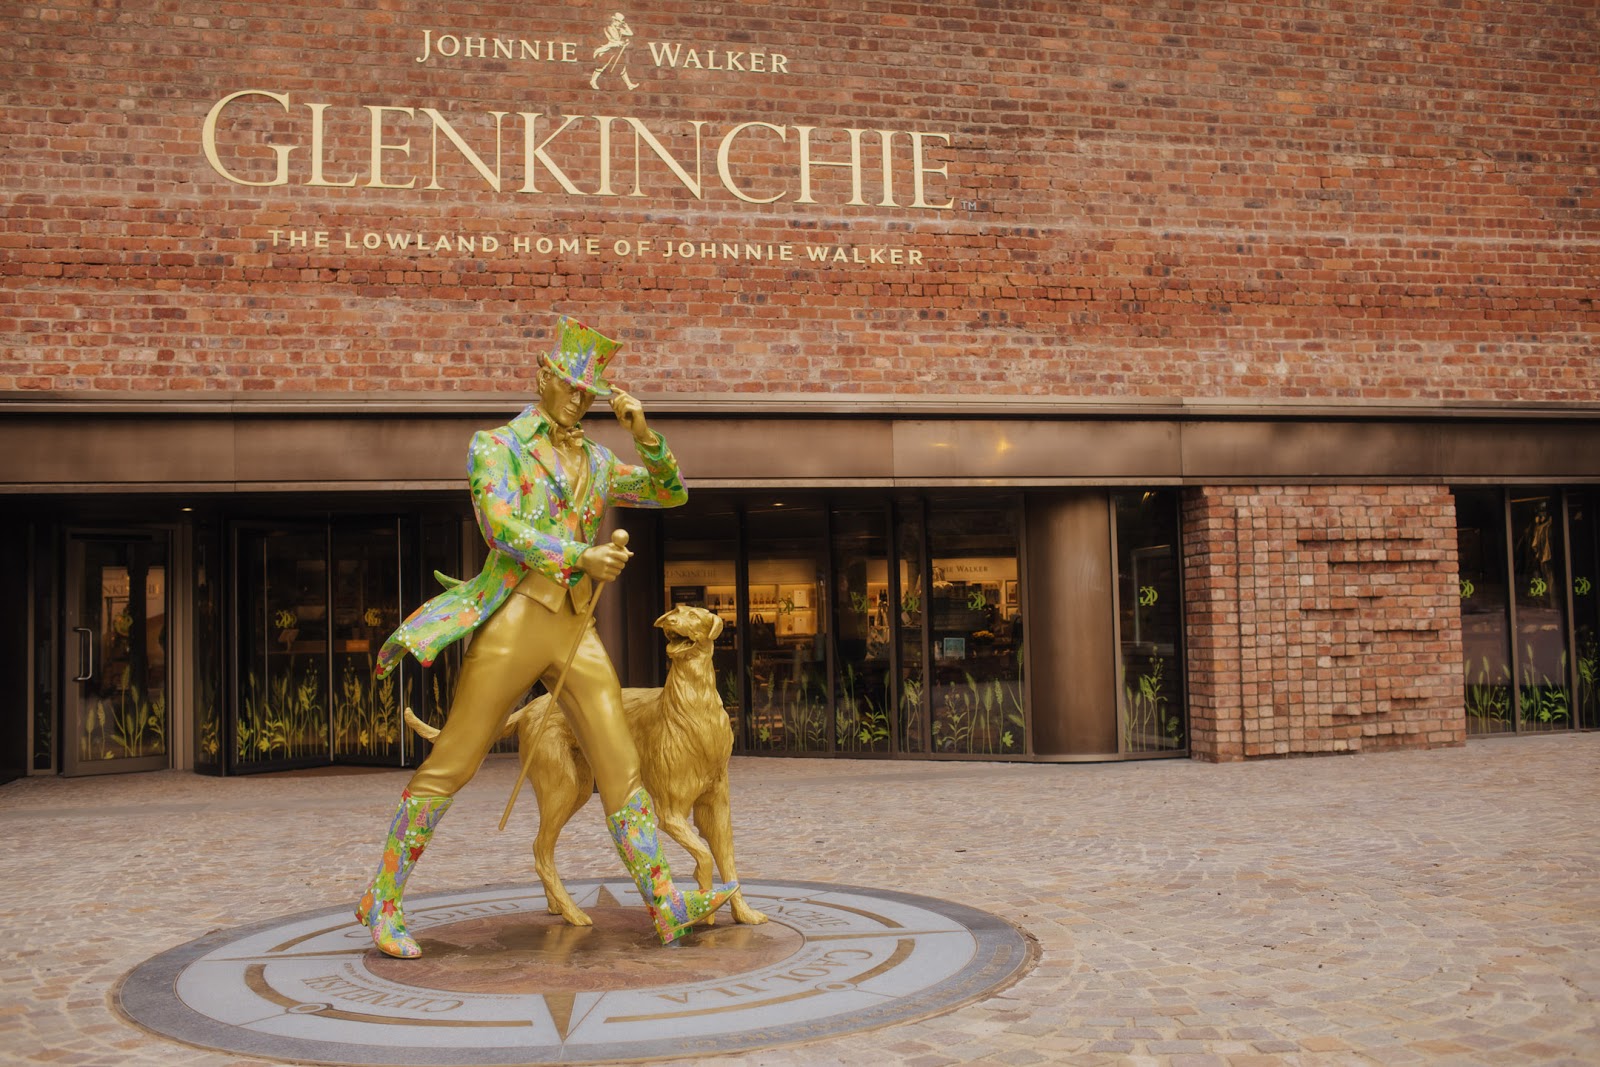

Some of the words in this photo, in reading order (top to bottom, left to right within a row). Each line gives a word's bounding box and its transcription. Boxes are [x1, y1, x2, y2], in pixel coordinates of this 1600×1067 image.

[417, 29, 578, 64] JOHNNIE
[649, 41, 789, 75] WALKER
[202, 88, 955, 211] GLENKINCHIE
[269, 229, 330, 250] THE
[345, 231, 500, 255] LOWLAND
[513, 235, 601, 257] HOME
[614, 239, 652, 258] OF
[662, 240, 794, 262] JOHNNIE
[806, 245, 924, 267] WALKER
[762, 948, 873, 983] CAOL
[302, 974, 464, 1012] CLYNELISH
[657, 982, 770, 1004] ILA
